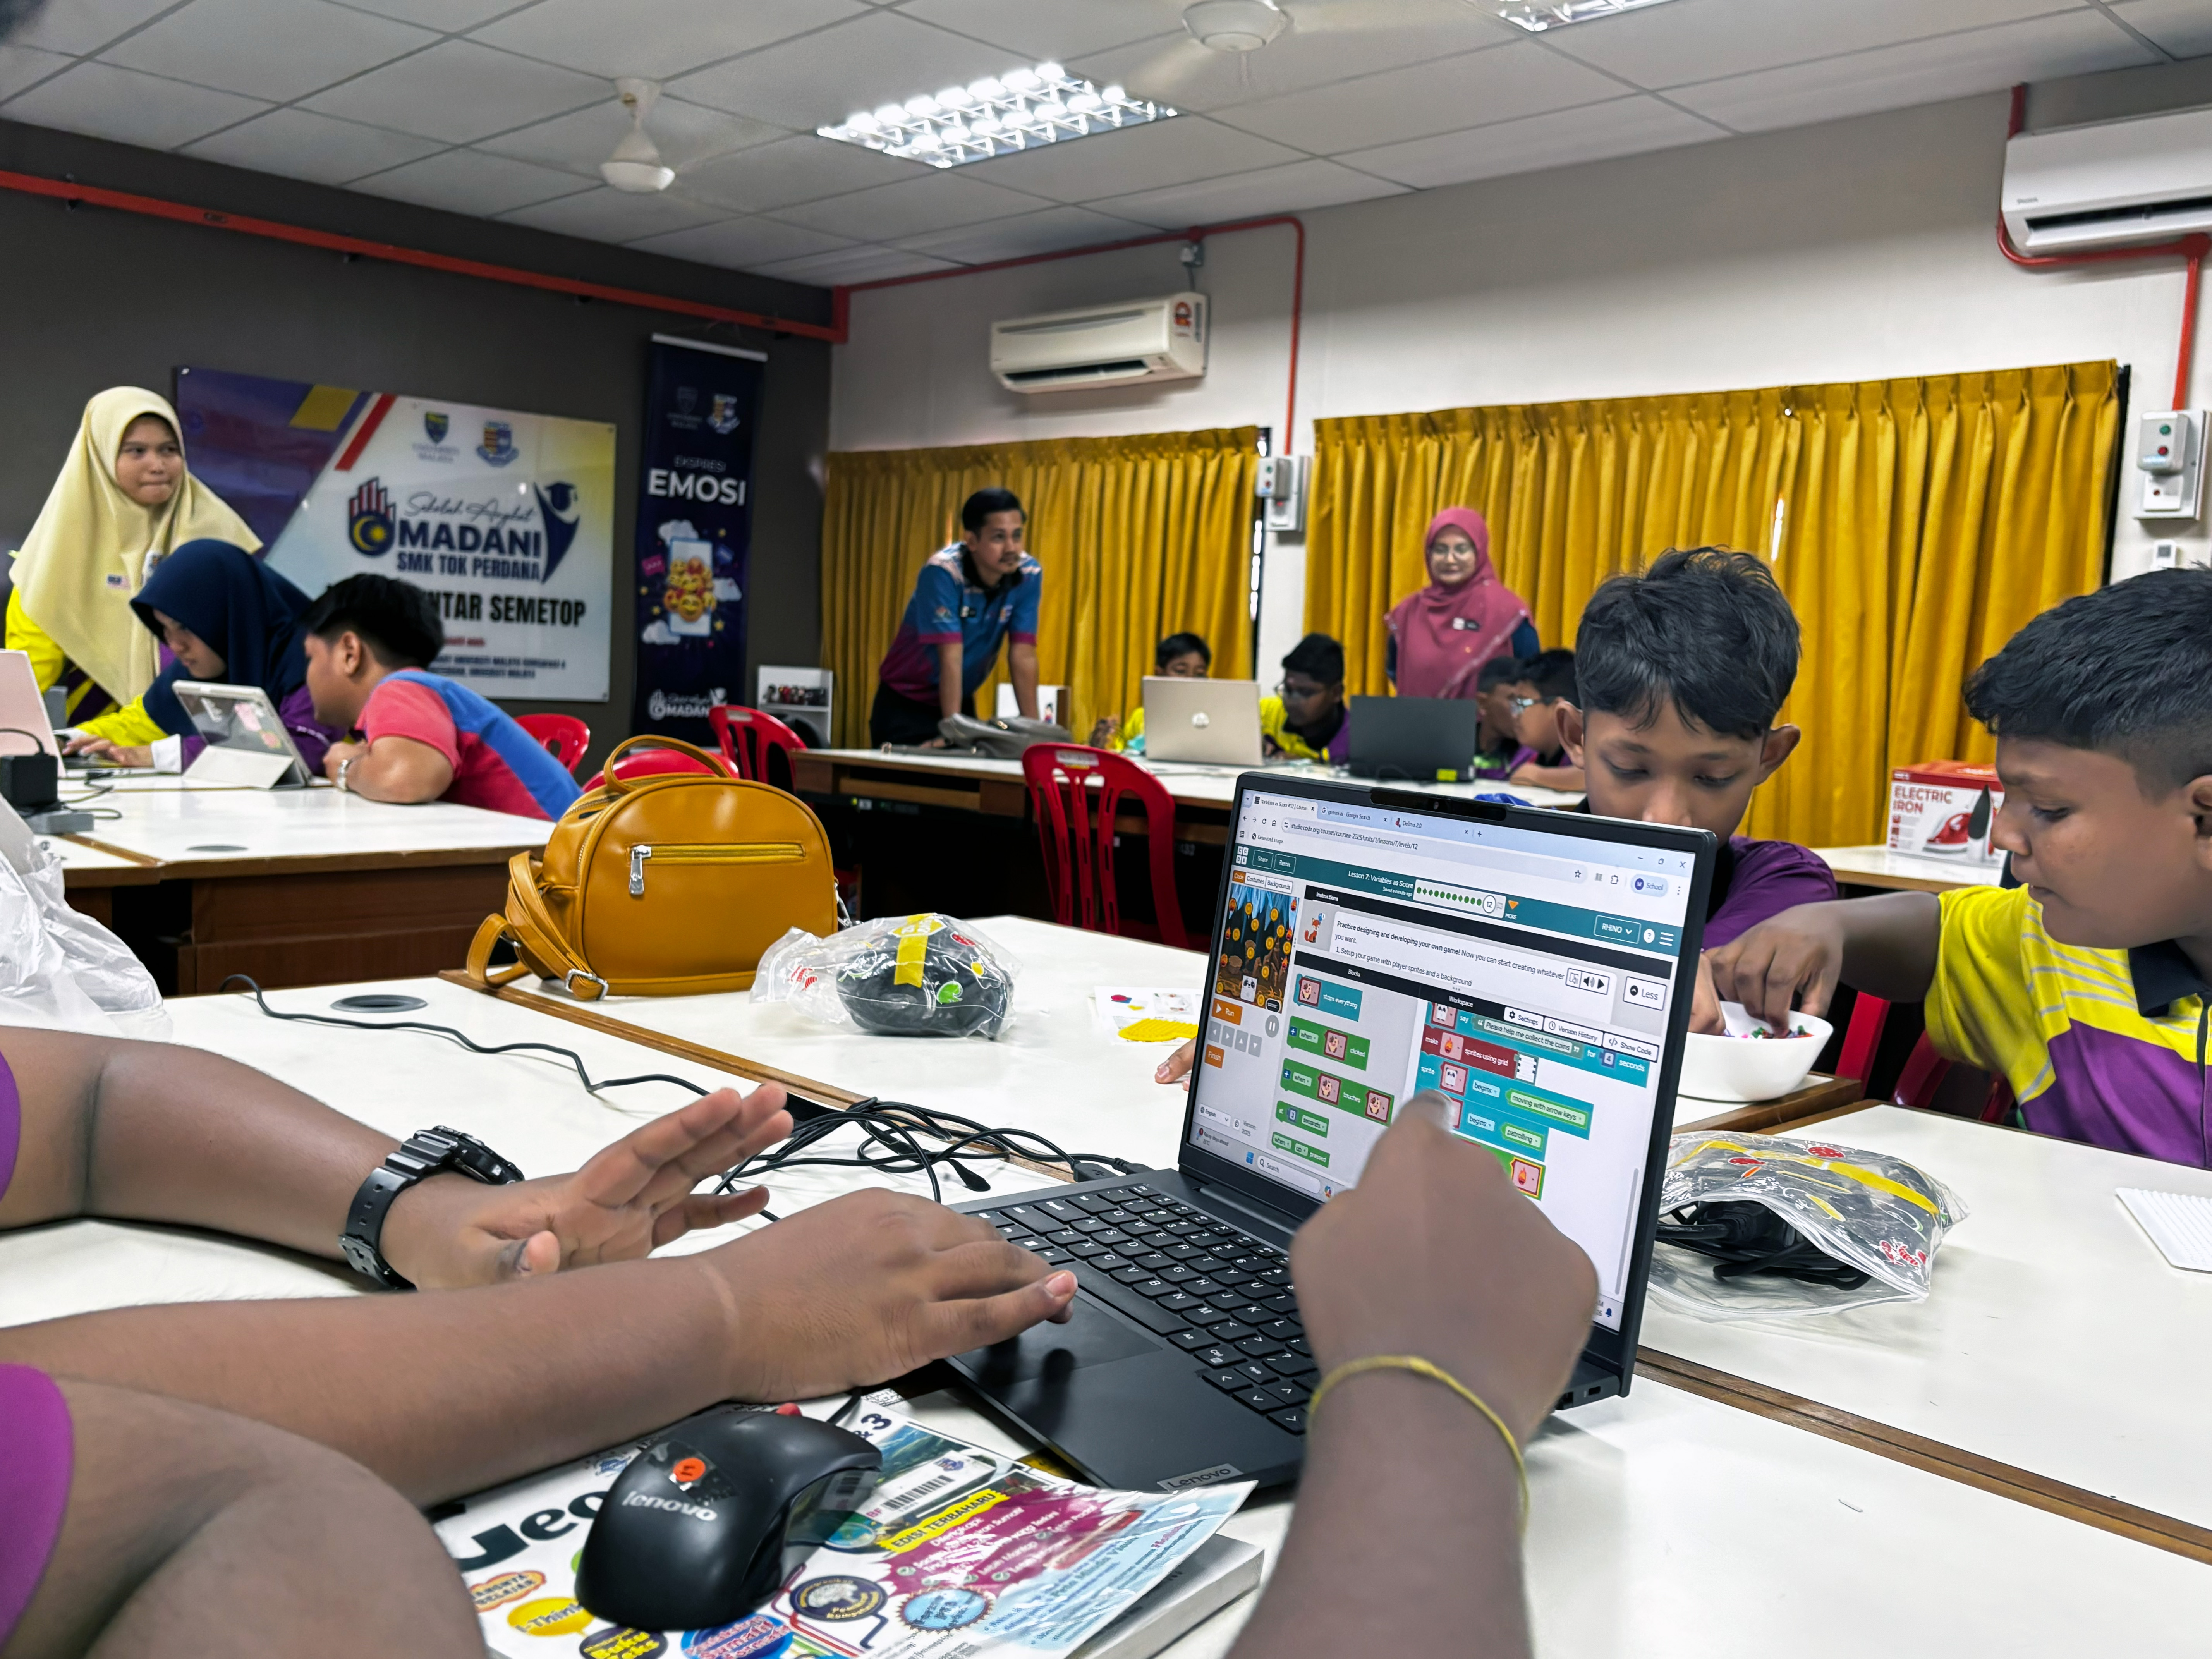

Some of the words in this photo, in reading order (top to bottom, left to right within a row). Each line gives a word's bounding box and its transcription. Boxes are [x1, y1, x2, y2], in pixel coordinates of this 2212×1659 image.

[648, 467, 746, 506] EMOSI
[398, 519, 541, 559] MADANI
[397, 551, 433, 573] SMK
[440, 555, 468, 576] TOK
[472, 558, 539, 580] PERDANA
[490, 594, 586, 626] SEMETOP
[666, 704, 709, 718] MADAN
[1894, 785, 1952, 804] ELECTRIC
[1894, 800, 1923, 814] IRON
[1247, 876, 1264, 884] Costumes
[1348, 870, 1365, 879] Lesson
[1371, 874, 1392, 885] Variables
[1399, 880, 1413, 889] Score
[1646, 882, 1664, 891] School
[1486, 900, 1493, 908] 12
[1602, 922, 1622, 934] RHINO
[1337, 920, 1356, 931] Practice
[1357, 925, 1379, 938] designing
[1380, 930, 1390, 939] and
[1391, 933, 1418, 947] developing
[1419, 941, 1431, 949] your
[1431, 943, 1443, 951] own
[1444, 946, 1460, 957] game!
[1462, 950, 1474, 959] Now
[1475, 954, 1486, 962] you
[1487, 956, 1497, 964] can
[1498, 958, 1511, 968] start
[1512, 962, 1535, 975] creating
[1537, 967, 1565, 980] whatever
[1341, 948, 1355, 958] Setup
[1367, 955, 1380, 964] game
[1381, 958, 1391, 967] with
[1392, 961, 1407, 971] player
[1408, 964, 1425, 975] sprites
[1425, 969, 1435, 977] and
[1441, 973, 1472, 987] background
[1348, 969, 1361, 978] Blocks
[1449, 995, 1473, 1008] Workspace
[1641, 988, 1658, 1001] Less
[1224, 1008, 1235, 1017] Run
[1518, 1014, 1539, 1026] Settings
[1558, 1025, 1576, 1037] Version
[1577, 1030, 1598, 1043] History
[1208, 1050, 1221, 1061] Finish
[1486, 1021, 1503, 1032] Please
[1503, 1025, 1515, 1036] help
[1525, 1031, 1544, 1044] collect
[1545, 1036, 1554, 1047] the
[1555, 1040, 1570, 1053] coins
[1587, 1049, 1596, 1059] for
[1619, 1058, 1645, 1072] seconds
[1620, 1041, 1636, 1052] Show
[1636, 1045, 1652, 1057] Code
[1465, 1048, 1482, 1061] sprites
[1482, 1052, 1496, 1065] using
[1497, 1056, 1509, 1066] grid
[1475, 1082, 1492, 1095] begins
[1512, 1094, 1532, 1108] moving
[1533, 1101, 1545, 1111] with
[1546, 1106, 1563, 1117] arrow
[1563, 1109, 1577, 1122] keys
[1469, 1115, 1487, 1128] begins
[1507, 1129, 1533, 1145] patrolling
[861, 1413, 892, 1430] 3
[1168, 1468, 1231, 1488] Lenovo
[622, 1491, 718, 1522] lenovo
[891, 1529, 927, 1548] EDISI
[924, 1493, 996, 1531] TERBAHARU
